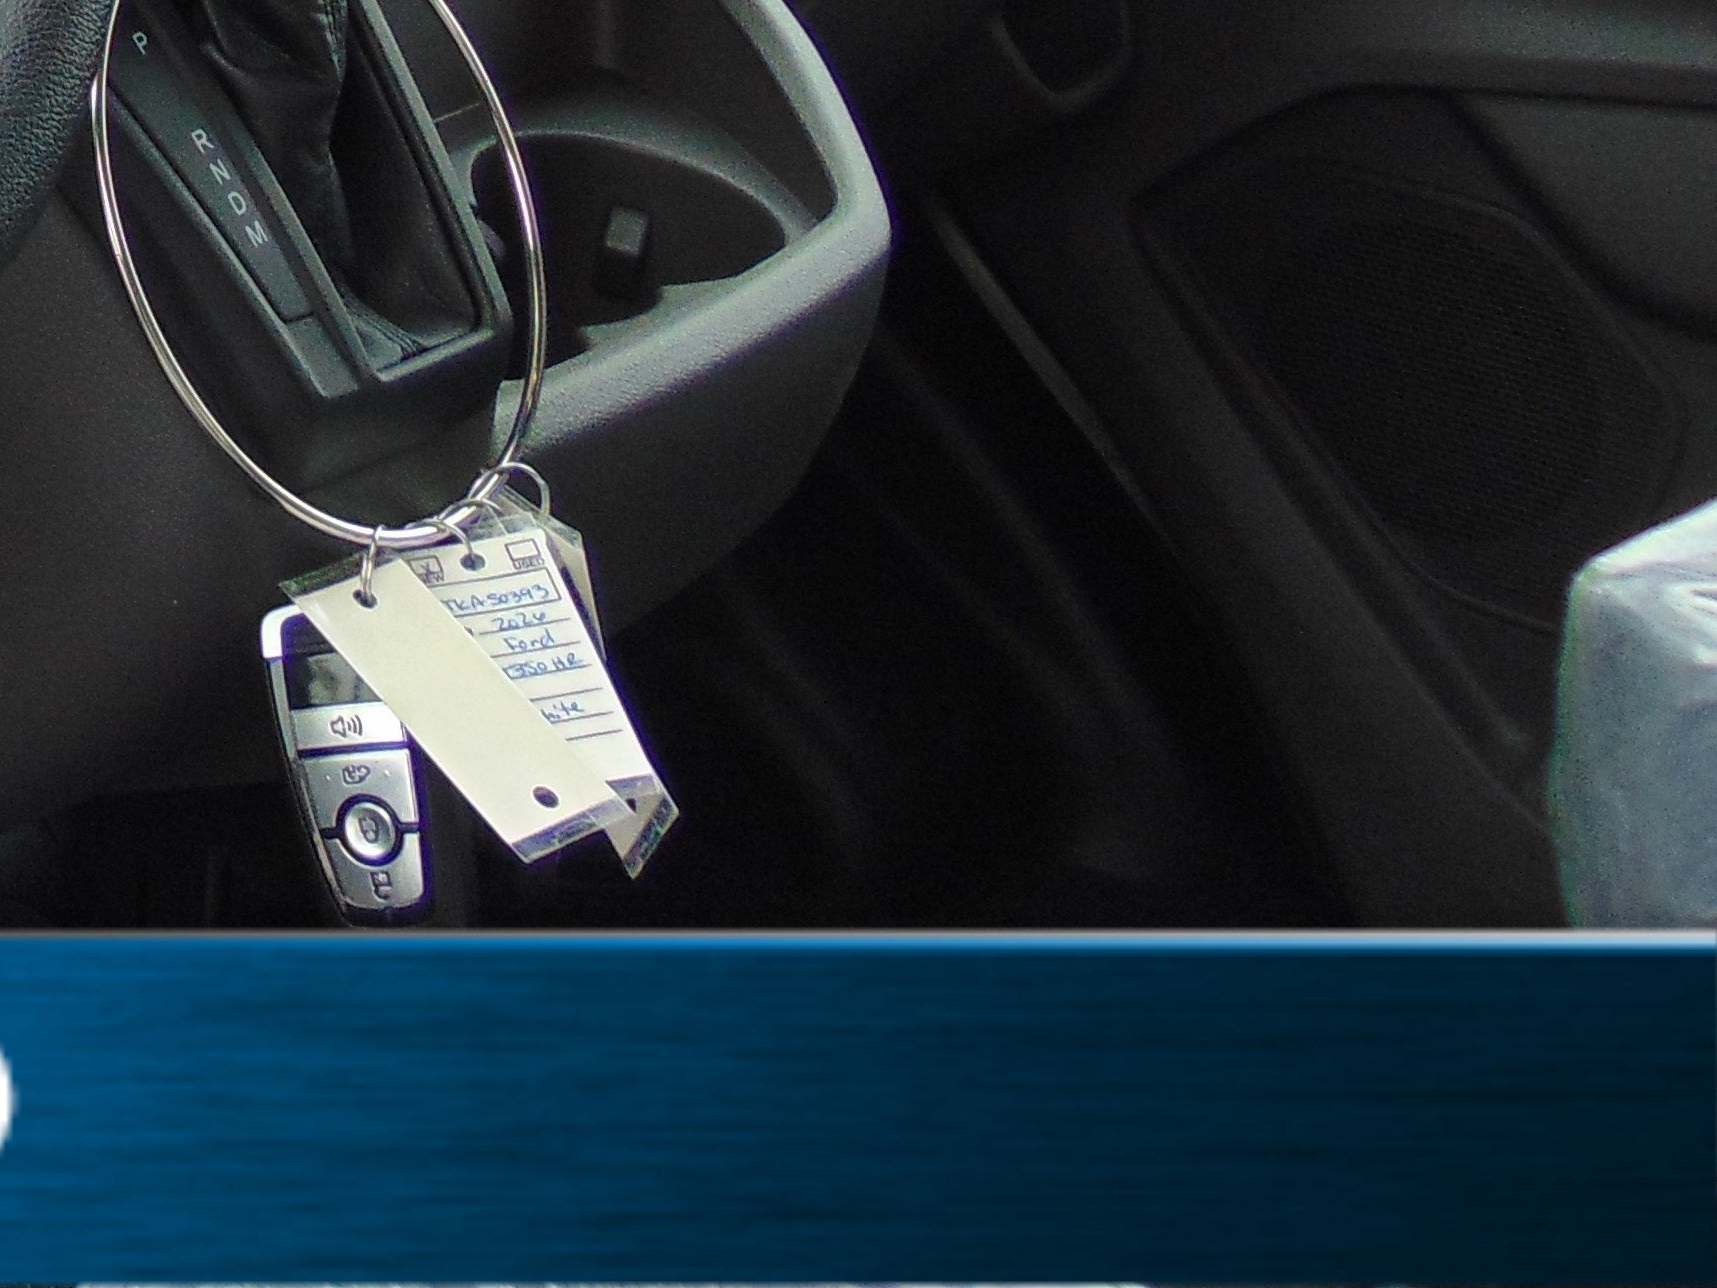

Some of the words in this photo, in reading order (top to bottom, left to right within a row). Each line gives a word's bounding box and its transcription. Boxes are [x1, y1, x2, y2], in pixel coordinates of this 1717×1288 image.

[132, 30, 148, 56] P
[190, 128, 214, 154] R
[209, 158, 232, 185] N
[227, 190, 248, 216] D
[245, 216, 268, 248] M
[502, 627, 557, 653] Ford
[539, 700, 585, 724] hite
